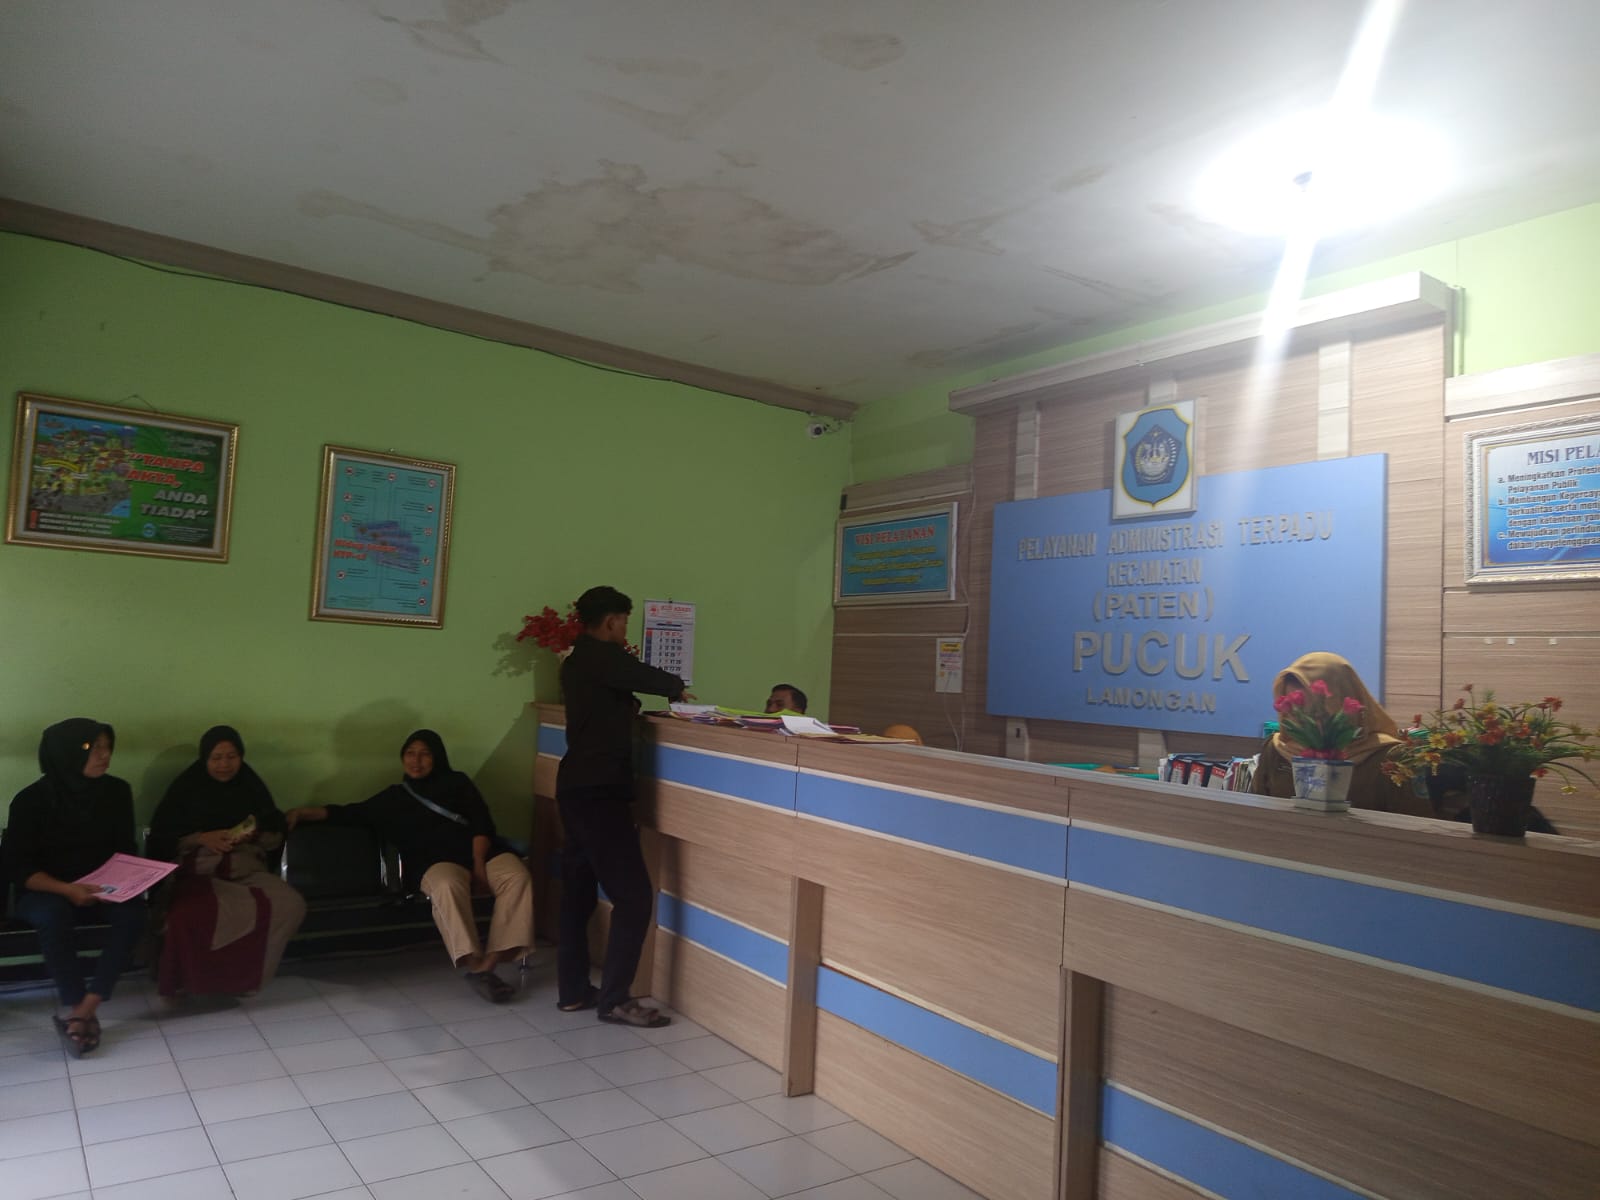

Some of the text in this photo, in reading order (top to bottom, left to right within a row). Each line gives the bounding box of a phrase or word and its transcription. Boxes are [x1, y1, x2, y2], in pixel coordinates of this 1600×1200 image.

[1527, 448, 1560, 465] MISI
[153, 489, 208, 505] ANDA
[1552, 479, 1578, 489] Publik
[1018, 510, 1332, 559] PELAYANAN ADMINISTRASI TERPADU
[1107, 557, 1203, 588] KECAMATAN
[1092, 586, 1215, 622] (PATEN)
[1072, 630, 1252, 684] PUCUK
[1086, 687, 1216, 714] LAMONGAN
